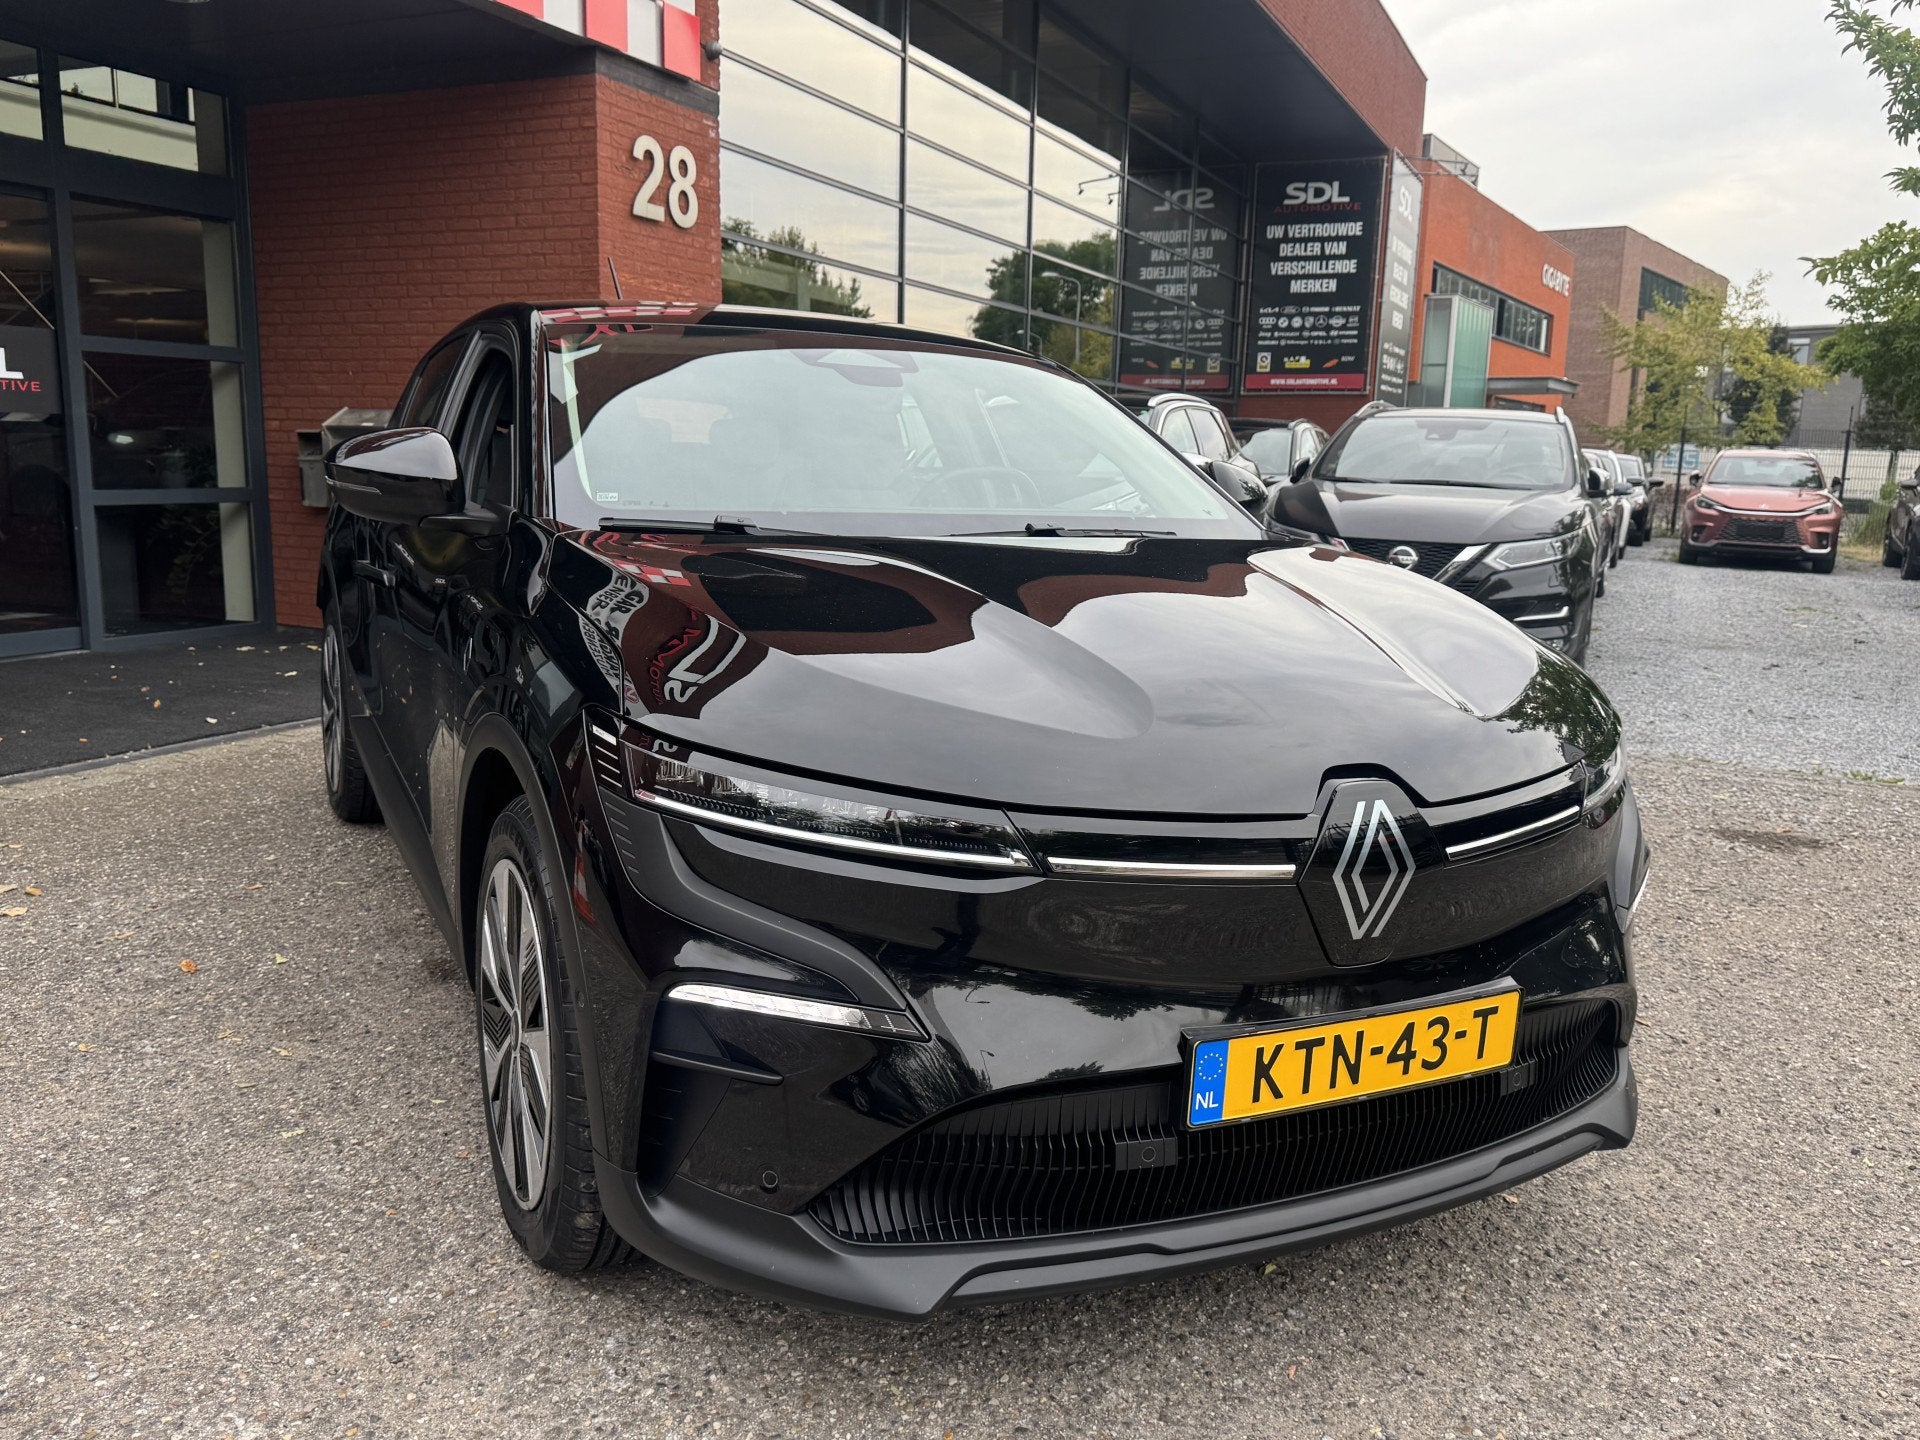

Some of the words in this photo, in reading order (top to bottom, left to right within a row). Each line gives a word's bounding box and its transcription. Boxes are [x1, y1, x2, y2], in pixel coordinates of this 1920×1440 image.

[632, 134, 699, 229] 28
[1283, 181, 1351, 205] SDL
[1273, 202, 1362, 214] AUTOMOTIVE
[1266, 224, 1285, 239] UW
[1287, 221, 1364, 239] VERTROUWDE
[1279, 242, 1322, 258] DEALER
[1323, 240, 1348, 256] VAN
[1269, 259, 1358, 276] VERSCHILLENDE
[1289, 278, 1338, 294] MERKEN
[1251, 1005, 1499, 1104] KTN-43-T
[1195, 1090, 1219, 1111] NL
